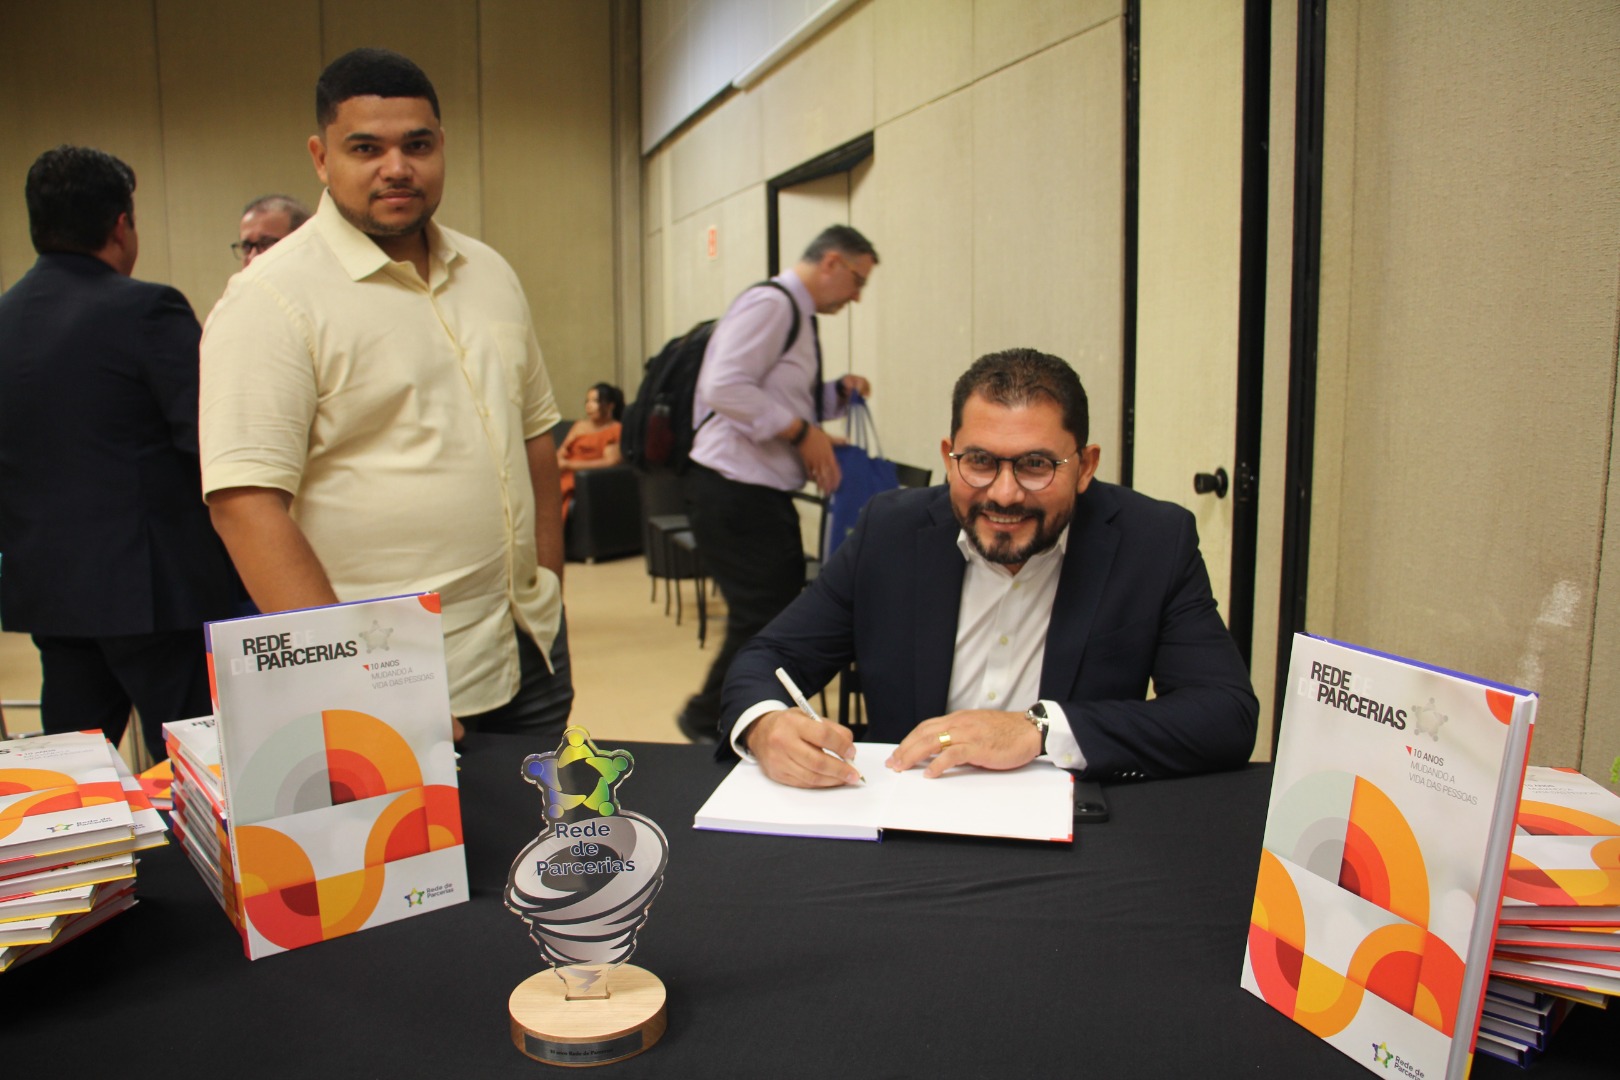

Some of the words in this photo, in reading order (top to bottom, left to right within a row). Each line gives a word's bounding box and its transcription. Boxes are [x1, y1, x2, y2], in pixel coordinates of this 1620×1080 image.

[242, 632, 292, 656] REDE
[256, 640, 358, 671] PARCERIAS
[380, 660, 400, 668] ANOS
[371, 667, 407, 680] MUDANDO
[372, 681, 388, 689] VIDA
[404, 673, 435, 684] PESSOAS
[1310, 660, 1352, 691] REDE
[1316, 683, 1407, 731] PARCERIAS
[1413, 748, 1422, 759] 10
[1422, 752, 1444, 767] ANOS
[1410, 760, 1449, 781] MUDANDO
[1449, 775, 1456, 784] A
[1409, 772, 1425, 785] VIDA
[1426, 778, 1441, 792] DAS
[1442, 785, 1478, 806] PESSOAS
[555, 821, 611, 839] Rede
[570, 841, 599, 857] de
[536, 856, 636, 876] Parcerias
[426, 885, 443, 893] Rede
[1395, 1055, 1413, 1071] Rede
[1414, 1069, 1424, 1079] de
